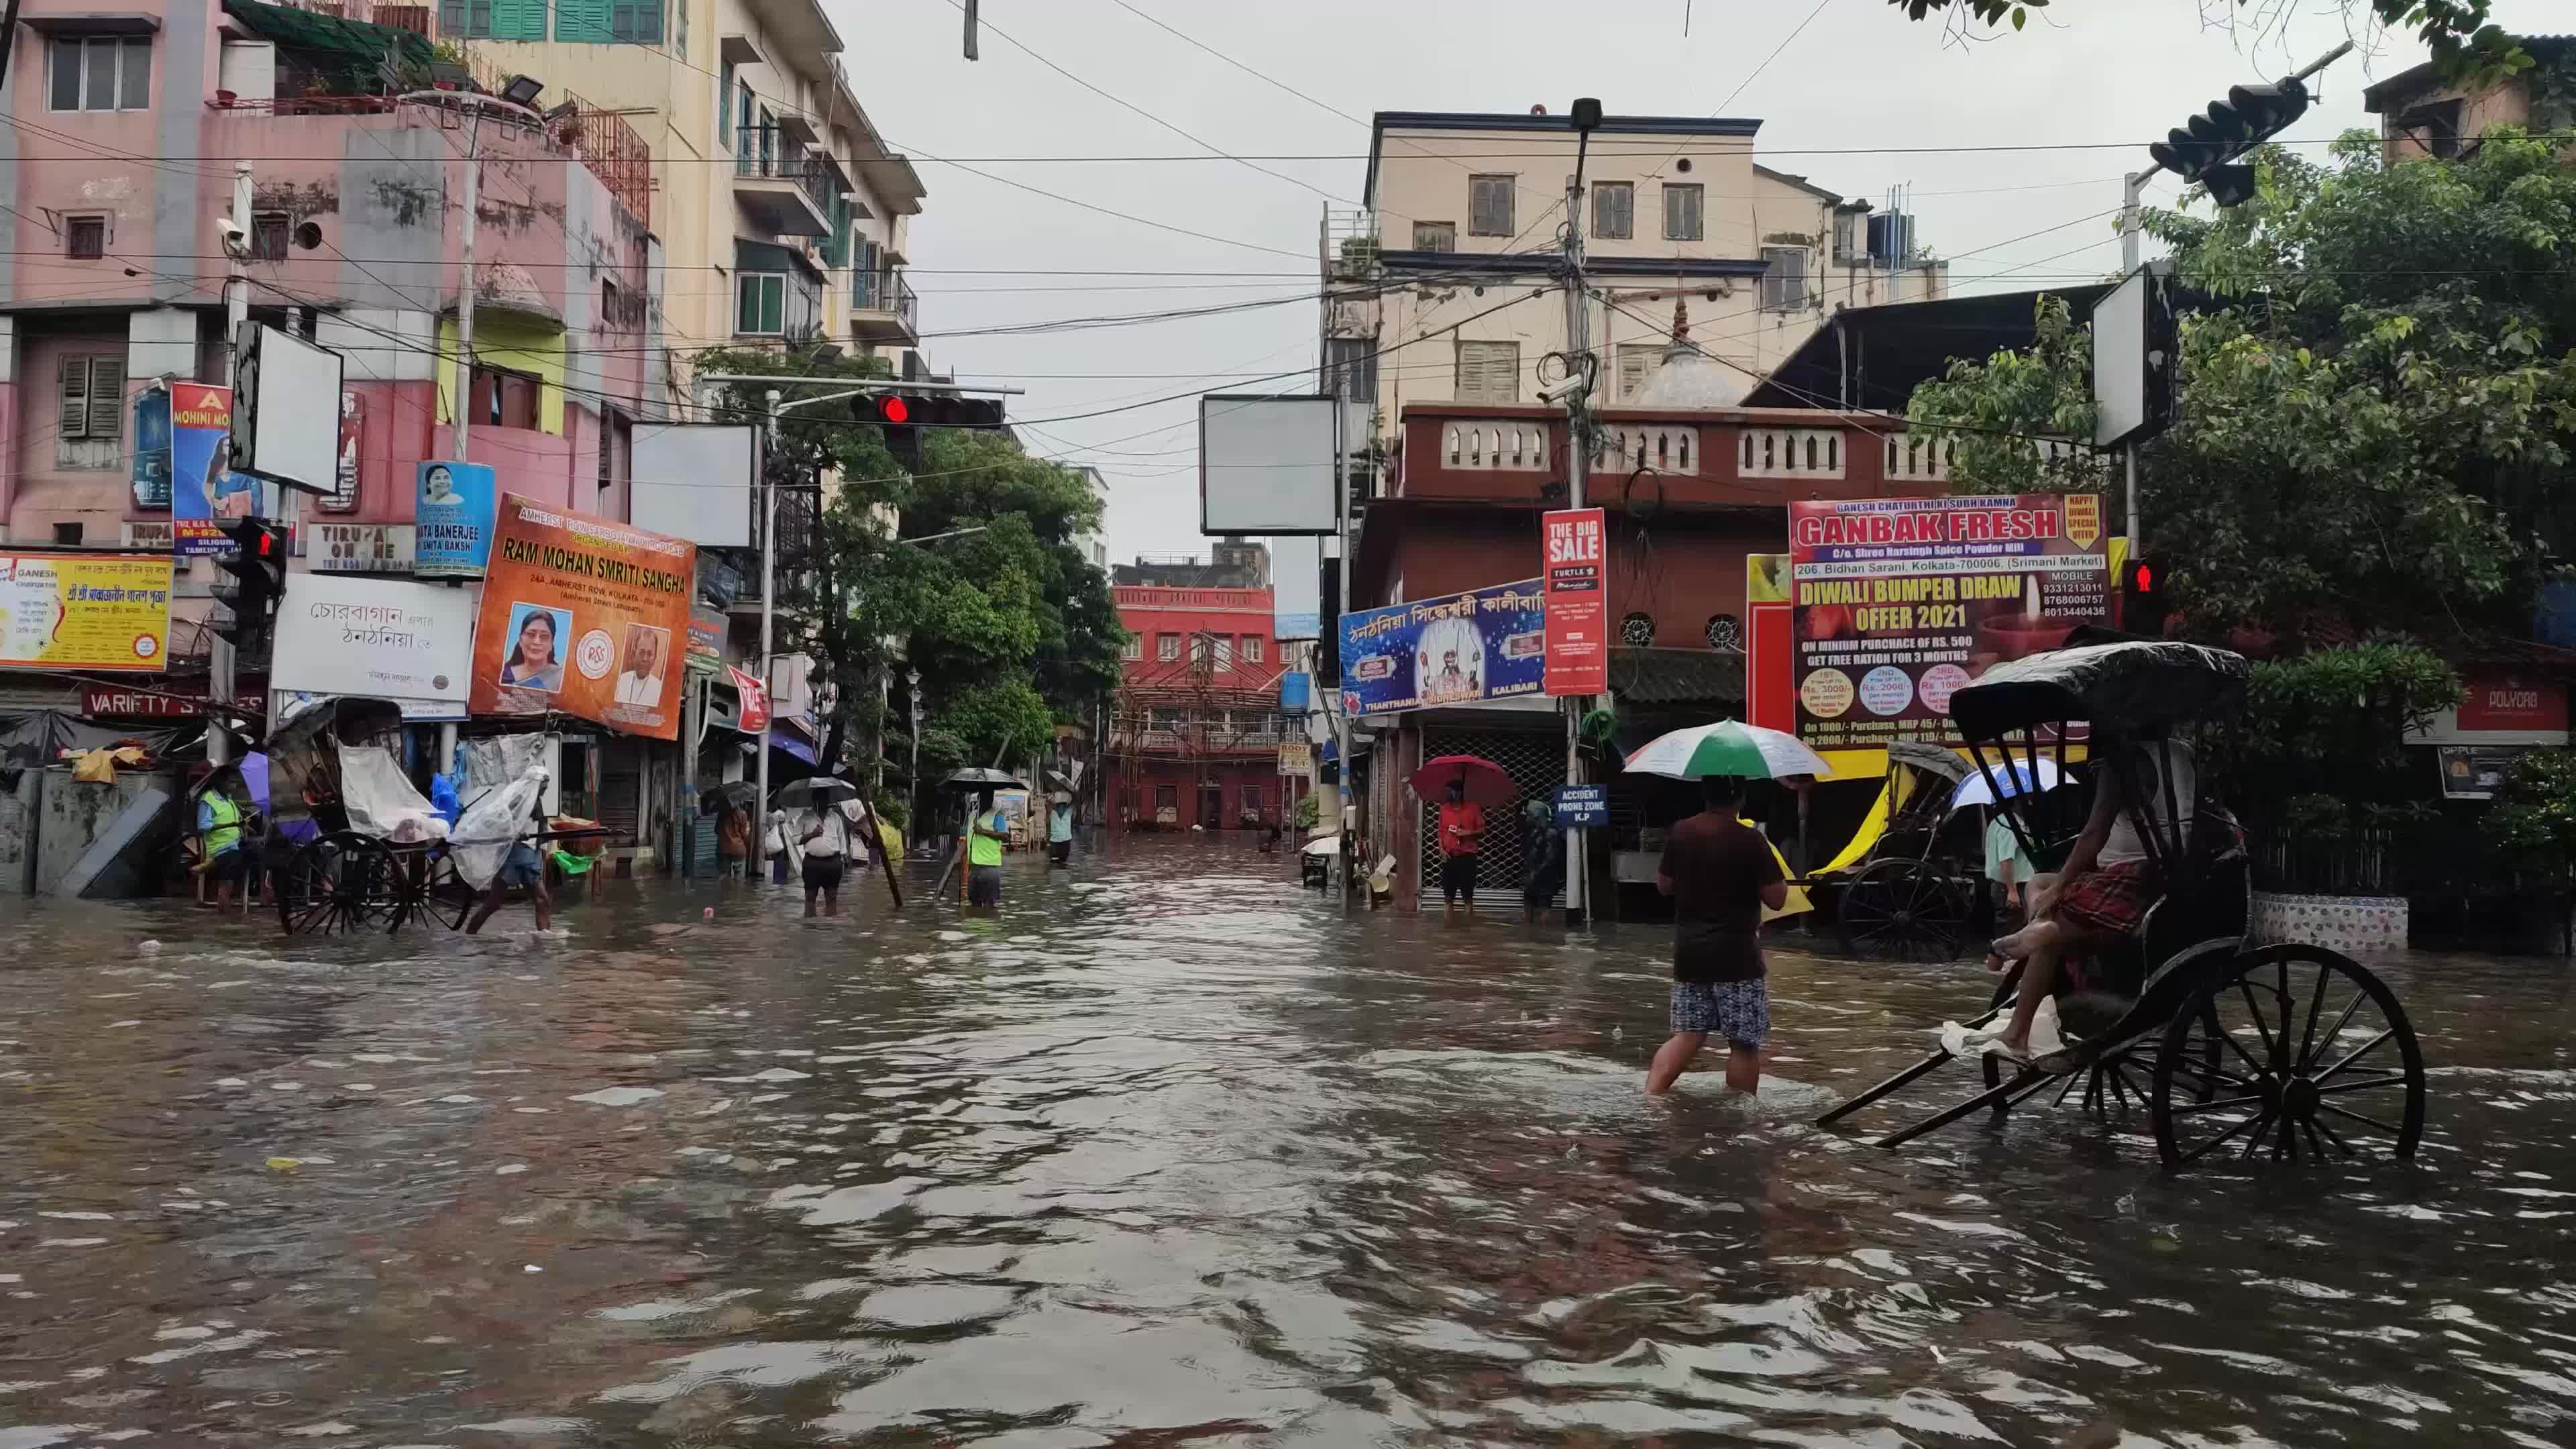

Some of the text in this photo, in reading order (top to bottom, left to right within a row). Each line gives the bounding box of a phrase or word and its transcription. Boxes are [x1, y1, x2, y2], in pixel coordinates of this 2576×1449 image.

[174, 411, 231, 425] MOHINI MO
[1837, 502, 1876, 513] GANESH
[1878, 500, 1935, 511] CHATURTHI
[1949, 498, 1978, 508] SUBH
[1980, 498, 2017, 508] KAMNA
[2070, 496, 2093, 505] HAPPY
[519, 507, 564, 529] AMHERST
[2069, 507, 2095, 517] DIWALI
[1549, 520, 1598, 538] THE BIG
[1797, 510, 2059, 547] GANBAK FRESH
[2068, 519, 2096, 528] SPECIAL
[434, 524, 478, 540] BANERJEE
[444, 541, 473, 552] BAKSHI
[1549, 535, 1599, 563] SALE
[1856, 547, 1884, 558] Shree
[1934, 544, 1963, 555] Spice
[1965, 543, 2003, 554] Powder
[2005, 542, 2025, 553] Mill
[503, 537, 686, 595] RAM MOHAN SMRITI SANGHA
[1825, 564, 1865, 574] Bidhan
[2007, 555, 2056, 570] (Srimani
[2059, 554, 2102, 568] Market)
[17, 569, 58, 578] GANESH
[1554, 568, 1584, 577] TURTLE
[2051, 571, 2094, 581] MOBILE
[549, 578, 587, 592] AMHERST
[1800, 575, 2021, 606] DIWALI BUMPER DRAW
[2043, 583, 2102, 594] 9331213011
[2043, 594, 2104, 605] 8768006757
[311, 602, 403, 625] চোরবাগান
[1856, 604, 1966, 632] OFFER 2021
[2044, 606, 2105, 617] 8013440436
[1350, 612, 1406, 643] ঠনঠনিয়া
[342, 623, 414, 649] ঠনঠনিয়া
[1801, 641, 1816, 653] ON
[1860, 638, 1917, 650] PURCHACE
[1917, 637, 1931, 648] OF
[1951, 635, 1973, 647] 500
[1807, 650, 1968, 666] GET FREE RATION FOR 3 MONTHS
[1492, 681, 1538, 695] KALIBARI
[1941, 680, 1965, 689] 1000/
[91, 693, 168, 713] VARIETY
[2489, 690, 2538, 709] POLYCAB
[1805, 722, 1818, 733] On
[1819, 721, 1849, 733] 1000/-
[1898, 719, 1919, 730] MRP
[1921, 718, 1941, 729] 45/-
[1803, 735, 1816, 746] On
[1817, 734, 1849, 745] 2000/-
[1898, 733, 1919, 742] MRP
[1562, 789, 1599, 800] ACCIDENT
[1558, 801, 1605, 812] PRONE ZONE
